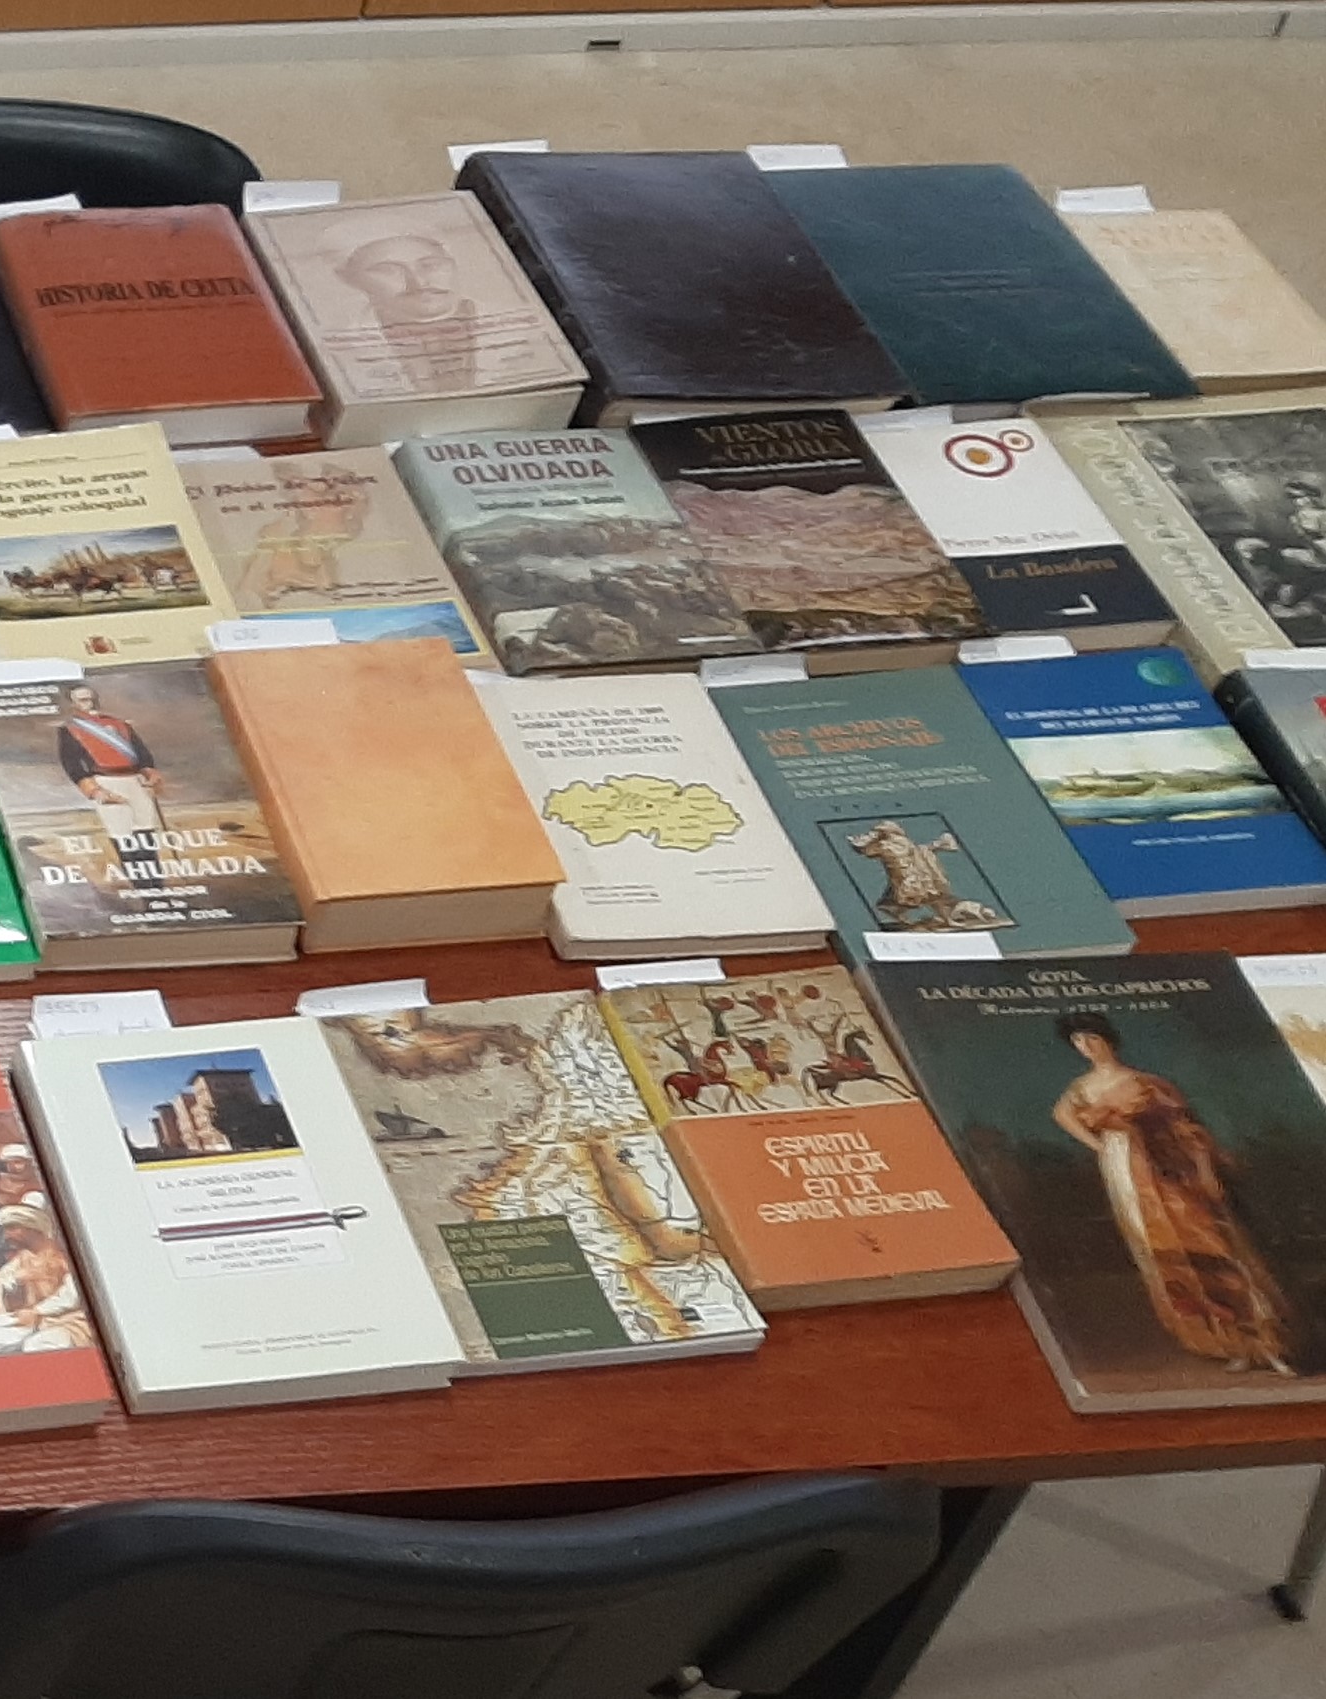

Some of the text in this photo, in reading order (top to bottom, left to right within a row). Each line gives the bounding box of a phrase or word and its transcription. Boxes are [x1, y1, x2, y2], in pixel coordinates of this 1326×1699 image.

[36, 275, 255, 308] HISTORIA DE CEUTA
[423, 435, 616, 464] UNA GUERRA
[58, 473, 84, 486] las
[89, 468, 149, 483] armas
[452, 457, 615, 486] OLVIDADA
[19, 488, 81, 506] guerra
[114, 482, 132, 495] el
[1023, 555, 1120, 579] Bandera
[59, 827, 228, 857] EL DUQUE
[40, 855, 267, 886] DE AHUMADA
[109, 909, 187, 924] GUARDIA
[1027, 967, 1091, 985] GOYA
[916, 985, 947, 1001] LA
[769, 1150, 891, 1179] Y MILICIA
[801, 1172, 882, 1199] EN LA
[844, 1188, 955, 1218] MEDIEVAL
